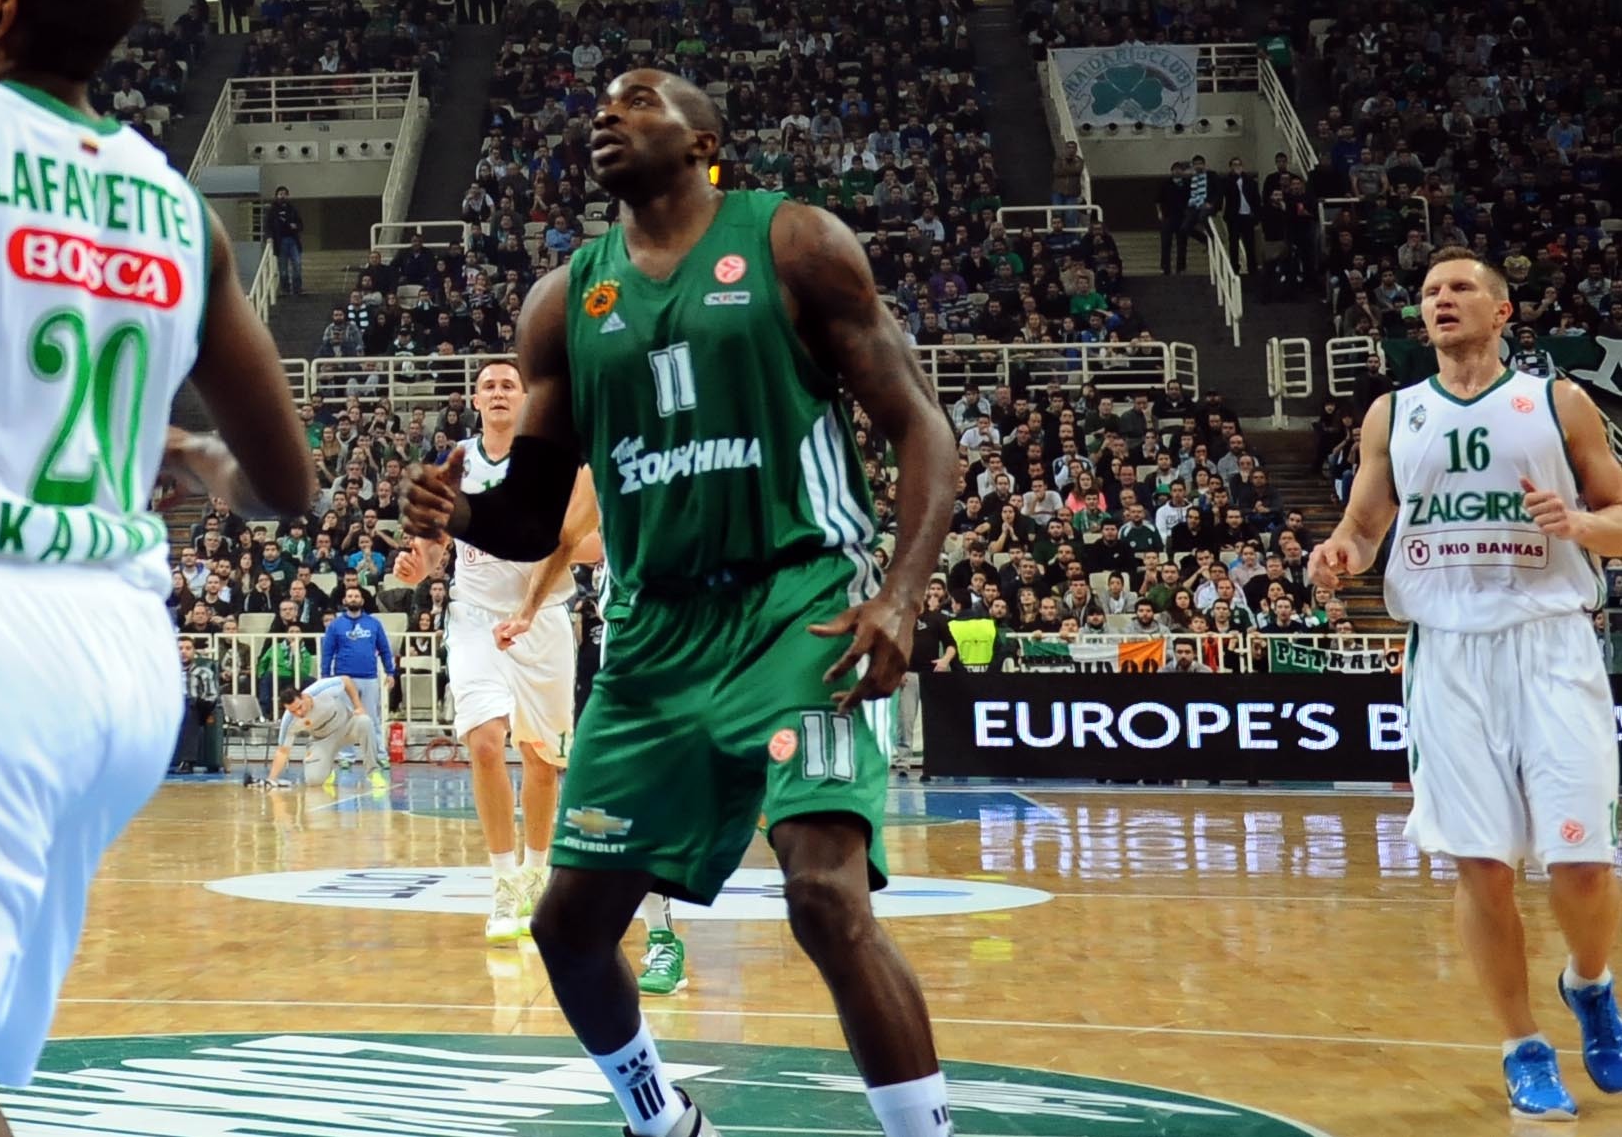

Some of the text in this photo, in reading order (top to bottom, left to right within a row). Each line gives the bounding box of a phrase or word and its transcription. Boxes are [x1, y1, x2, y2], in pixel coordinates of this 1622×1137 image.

[23, 233, 169, 303] BOSCA
[27, 304, 149, 514] 20
[648, 341, 696, 418] 11
[1443, 426, 1491, 474] 16
[1476, 542, 1544, 557] BANKAS
[1275, 640, 1401, 671] PETRALO
[798, 709, 857, 783] 11
[974, 701, 1340, 751] EUROPE'S
